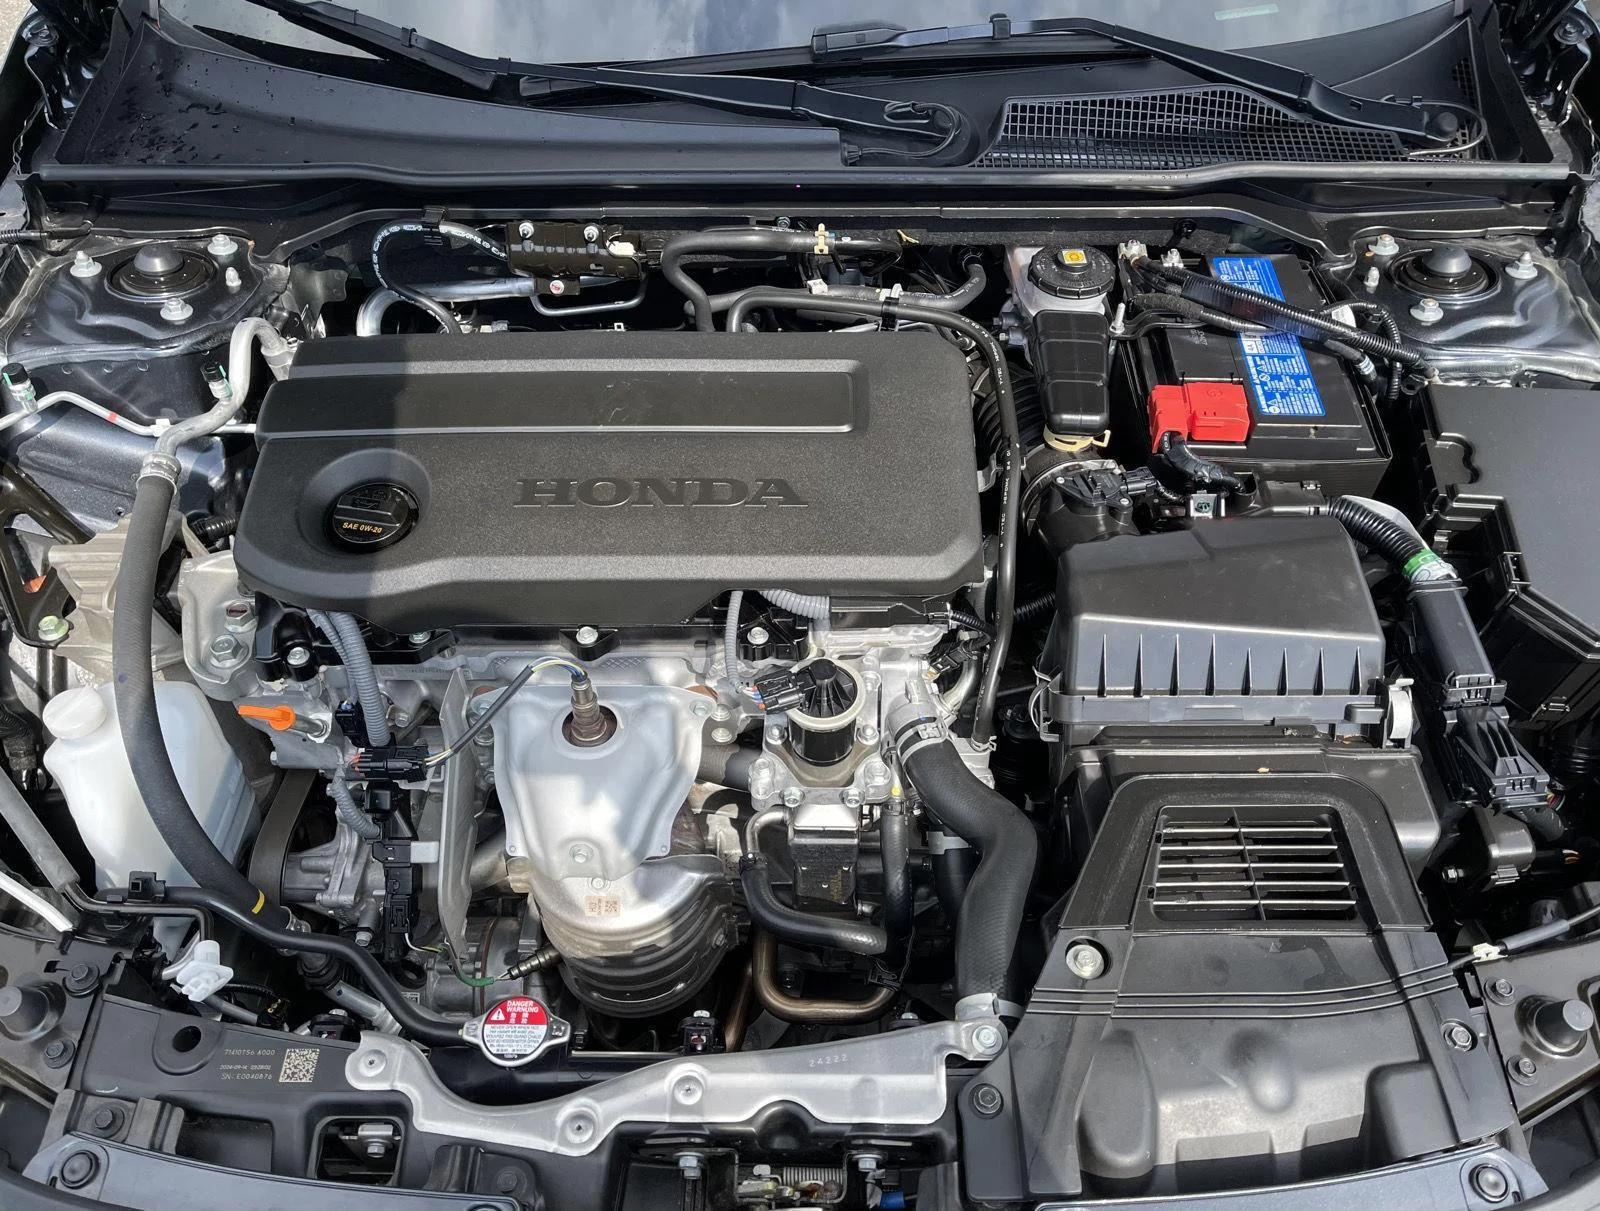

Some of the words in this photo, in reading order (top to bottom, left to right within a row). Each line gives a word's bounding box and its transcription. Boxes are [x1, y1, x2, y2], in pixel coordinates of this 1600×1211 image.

[513, 477, 809, 508] HONDA
[342, 522, 359, 531] SAE
[359, 525, 383, 534] 0W-20
